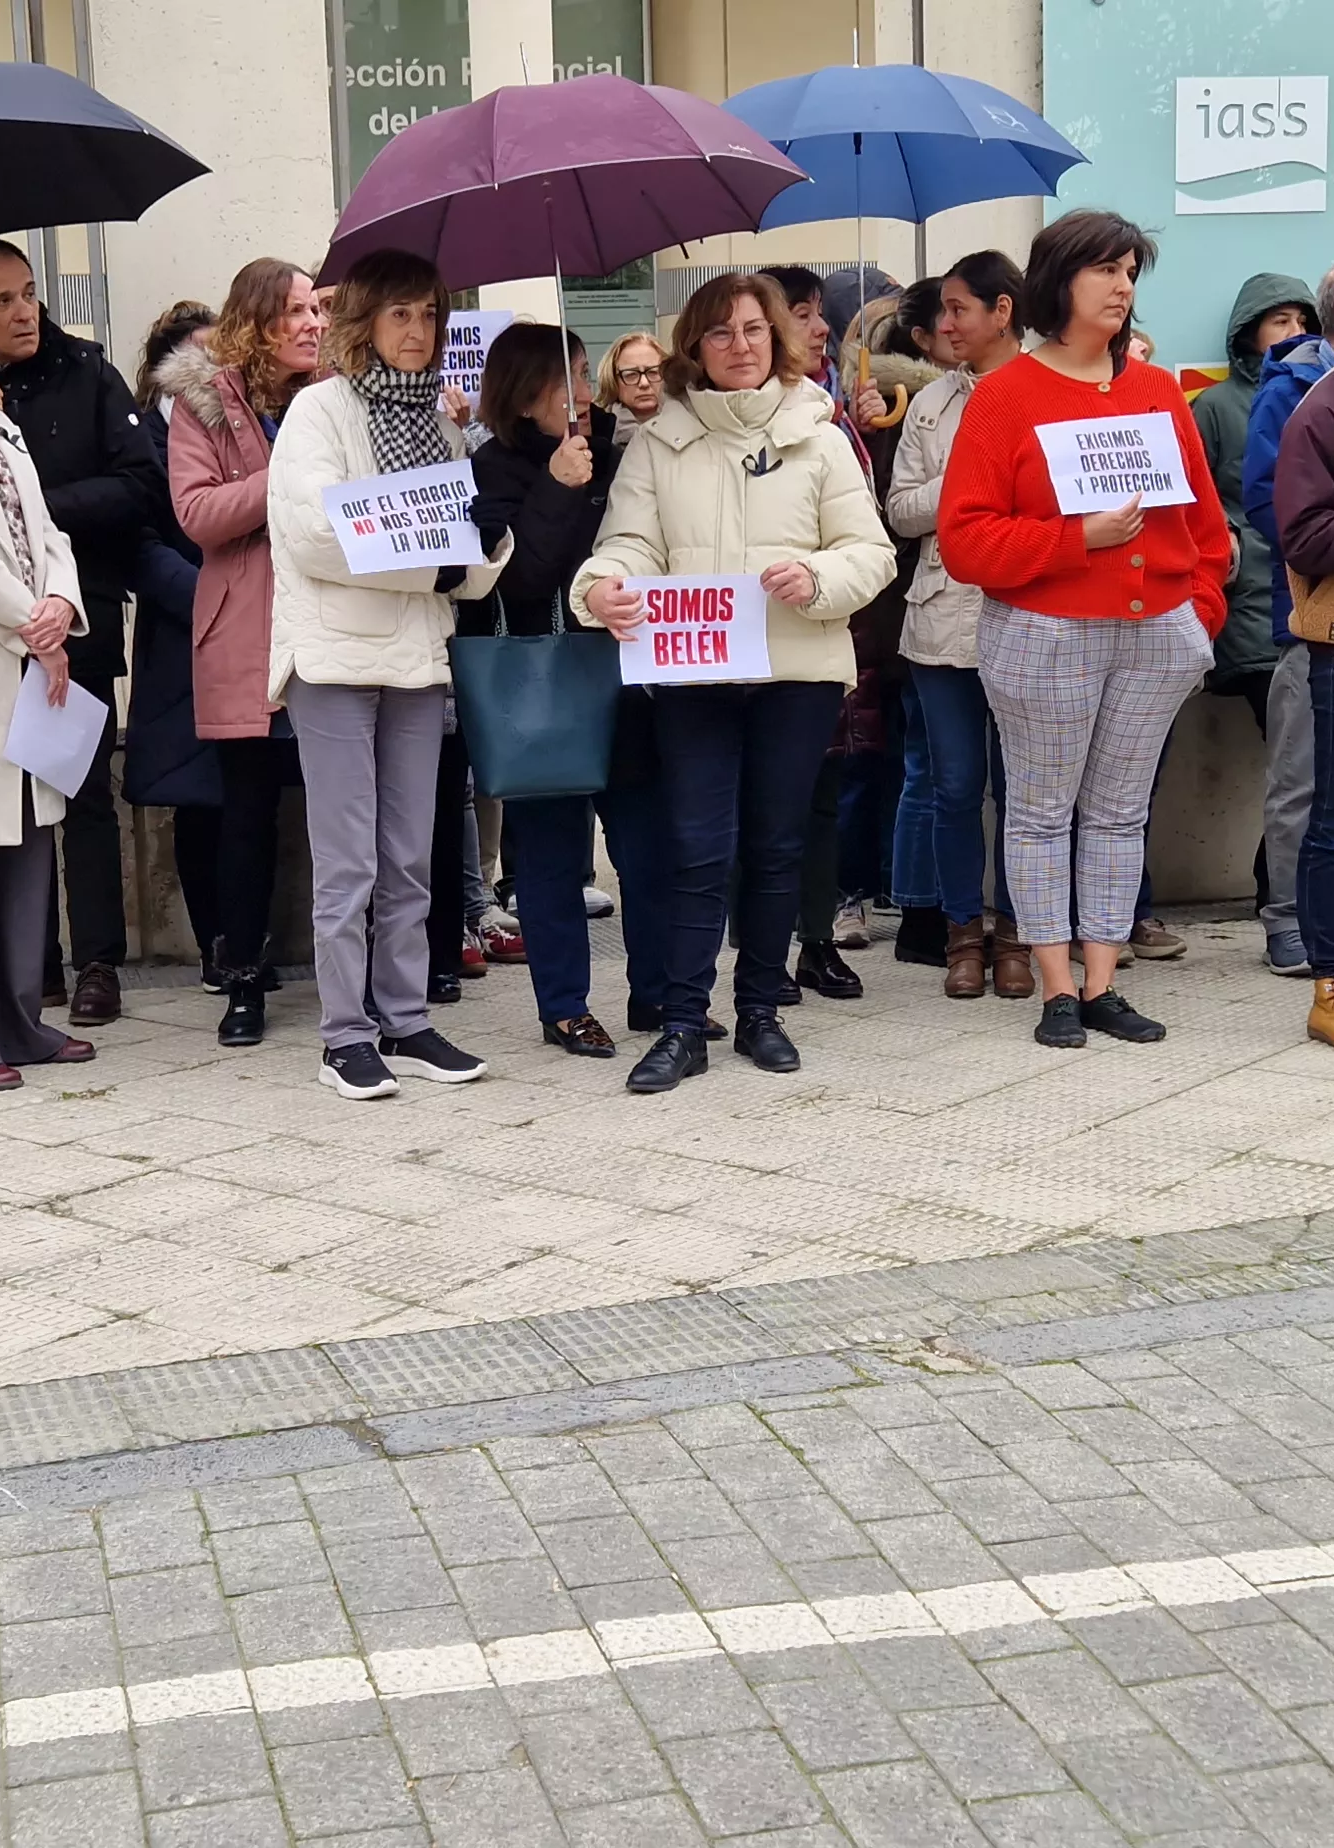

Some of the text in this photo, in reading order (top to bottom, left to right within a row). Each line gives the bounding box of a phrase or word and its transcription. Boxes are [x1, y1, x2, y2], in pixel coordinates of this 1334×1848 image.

[369, 106, 417, 135] del
[1195, 88, 1308, 138] iass
[1075, 429, 1144, 450] EXIGIMOS
[1080, 450, 1152, 473] DERECHOS
[1074, 469, 1174, 495] Y PROTECCIÓN
[341, 480, 468, 519] QUE EL TRABAJO
[352, 500, 470, 536] NO NOS CUESTE
[390, 528, 451, 553] LA VIDA
[647, 587, 734, 623] SOMOS
[653, 624, 729, 666] BELÉN
